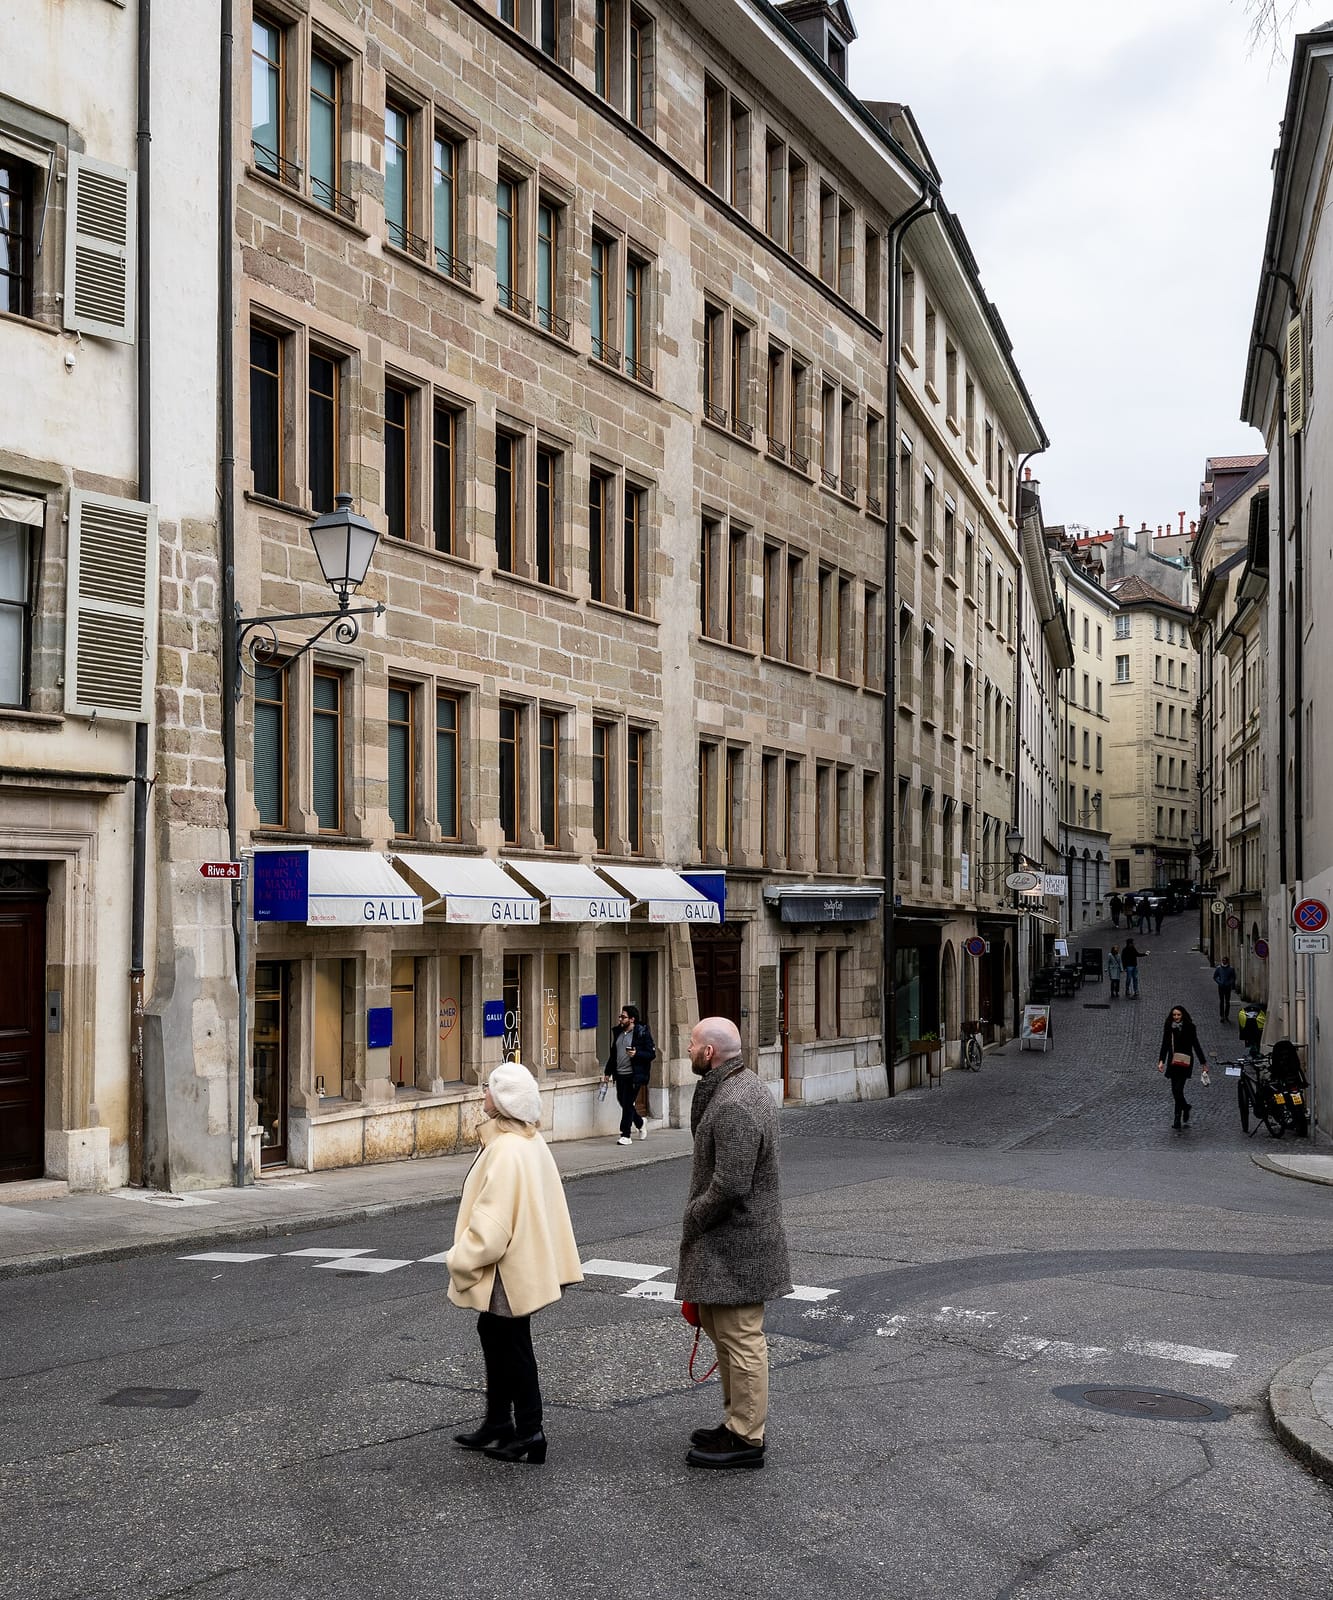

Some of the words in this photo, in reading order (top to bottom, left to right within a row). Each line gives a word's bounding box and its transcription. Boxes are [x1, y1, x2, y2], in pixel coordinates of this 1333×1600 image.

[207, 865, 225, 876] Rive
[363, 901, 417, 921] GALLI
[491, 902, 534, 920] GALLI
[589, 901, 626, 918] GALLI
[1214, 903, 1222, 912] g
[439, 1019, 452, 1028] ALLI
[547, 1007, 557, 1026] &
